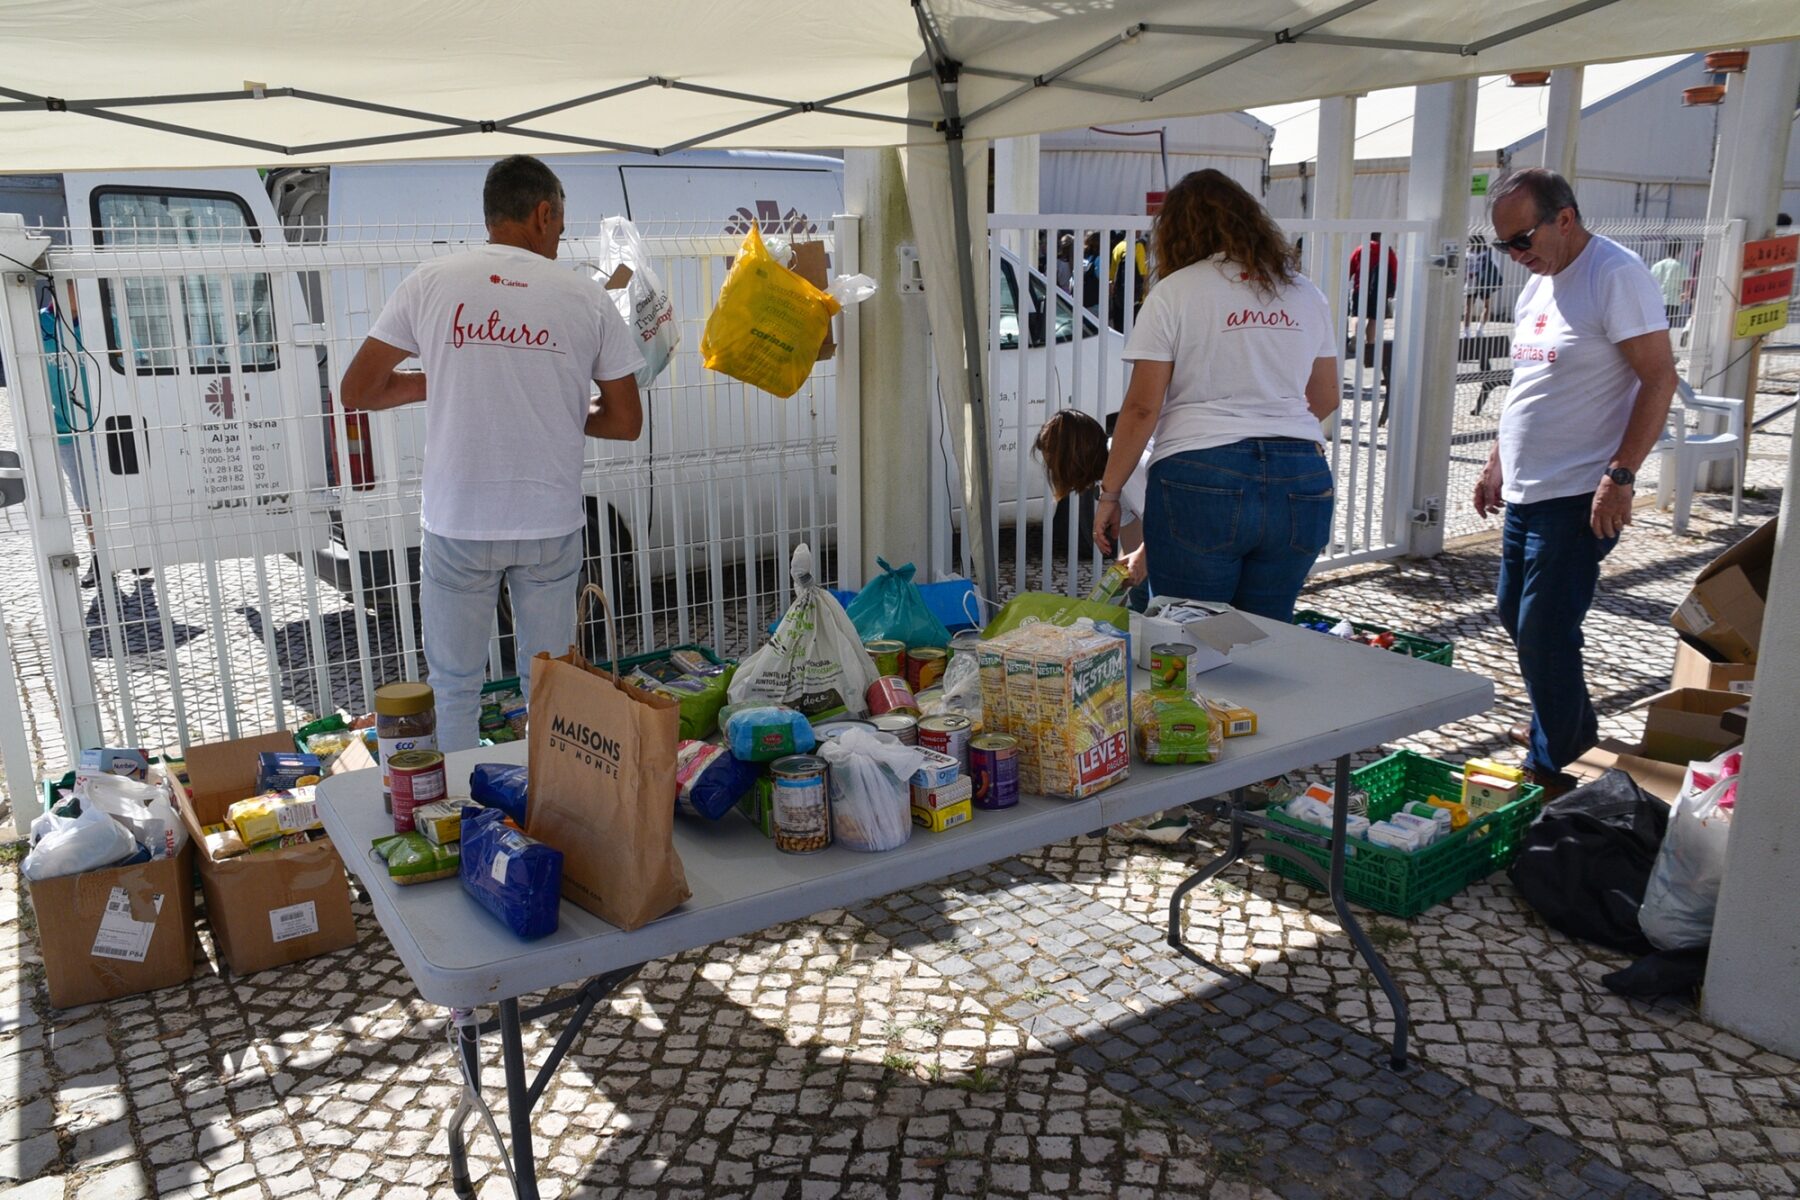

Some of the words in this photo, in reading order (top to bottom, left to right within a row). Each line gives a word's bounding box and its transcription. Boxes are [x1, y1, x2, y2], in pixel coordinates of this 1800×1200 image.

[453, 303, 557, 349] futuro.
[1227, 309, 1299, 327] amor.
[1750, 309, 1779, 327] FELIZ
[1547, 346, 1557, 363] é
[1072, 651, 1123, 697] NESTUM
[552, 714, 621, 761] MAISONS
[1080, 738, 1115, 774] LEVE
[1118, 733, 1127, 752] 3
[550, 738, 566, 752] DU
[575, 751, 618, 780] MONDE
